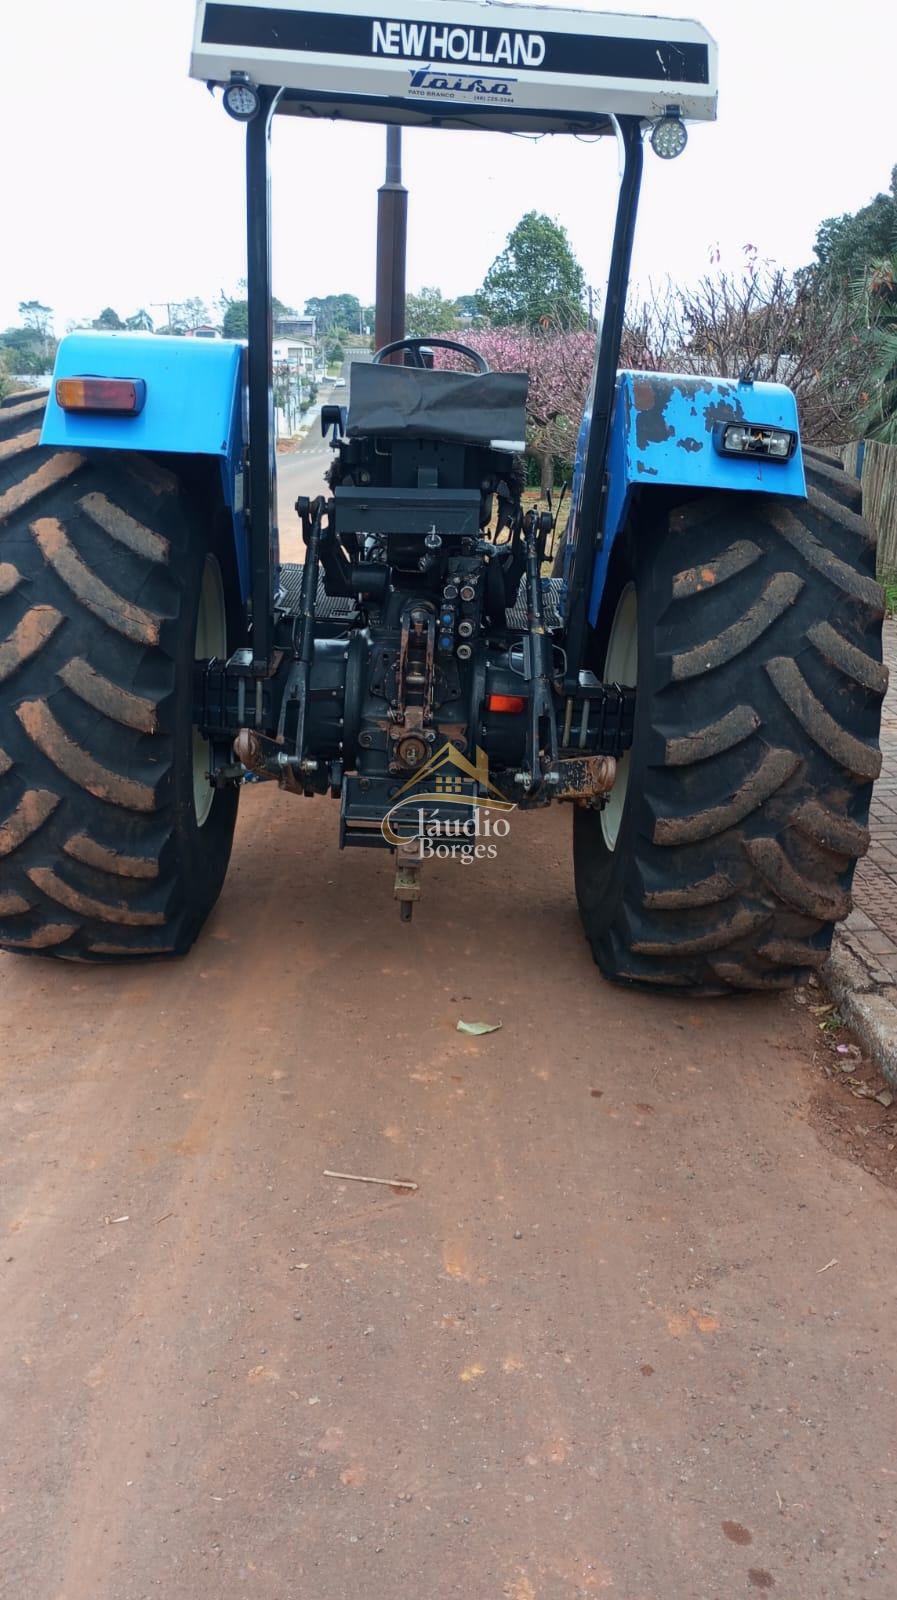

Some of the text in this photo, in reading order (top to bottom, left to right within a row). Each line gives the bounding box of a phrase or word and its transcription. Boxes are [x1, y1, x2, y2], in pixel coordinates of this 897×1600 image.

[372, 21, 546, 66] NEW HOLLAND
[408, 89, 425, 97] PATO
